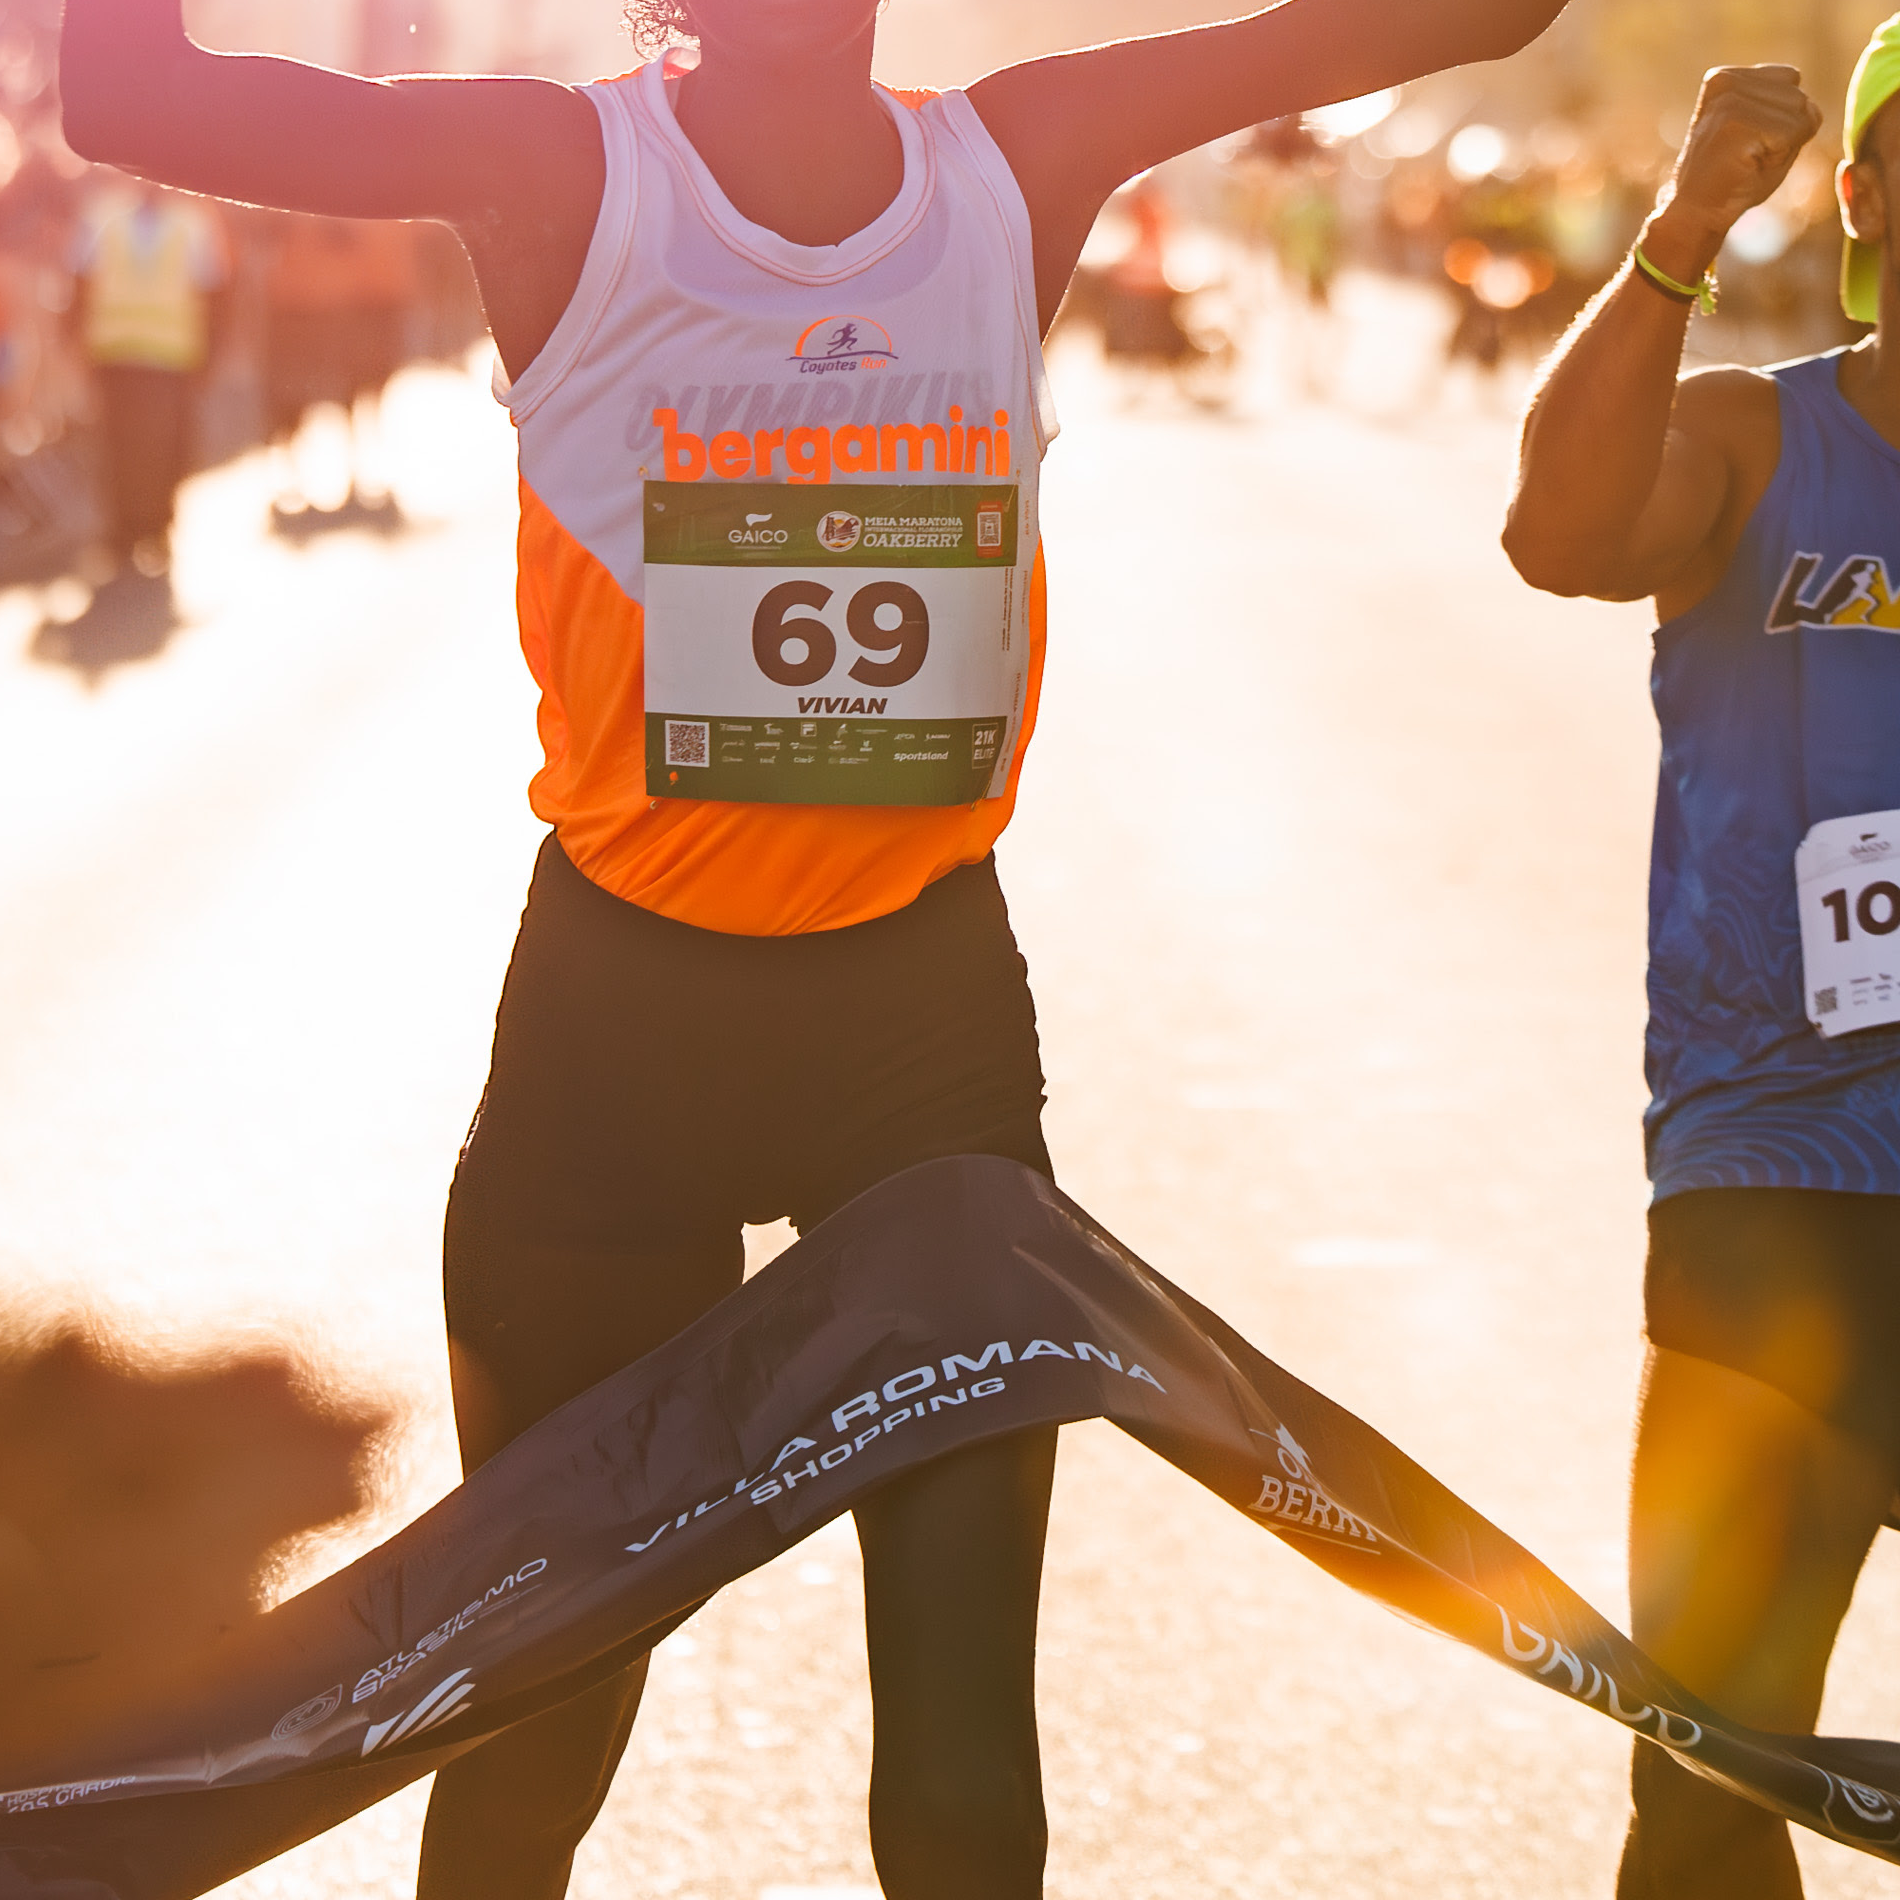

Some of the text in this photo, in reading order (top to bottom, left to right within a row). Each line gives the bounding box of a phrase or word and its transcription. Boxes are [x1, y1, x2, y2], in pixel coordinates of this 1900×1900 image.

[800, 356, 887, 375] Coyotes Run
[652, 404, 1011, 485] bergamini
[864, 516, 964, 527] MEIA MARATONA
[728, 529, 789, 544] GAICO
[863, 533, 963, 548] OAKBERRY
[752, 579, 930, 688] 69
[797, 697, 888, 714] VIVIAN
[974, 729, 997, 746] 21K
[893, 750, 949, 762] sportsland
[973, 747, 996, 761] ELITE
[624, 1338, 1169, 1553] VILLA ROMANA
[749, 1376, 1006, 1506] SHOPPING
[353, 1557, 548, 1691] ATLETISMO
[352, 1618, 476, 1704] BRASIL
